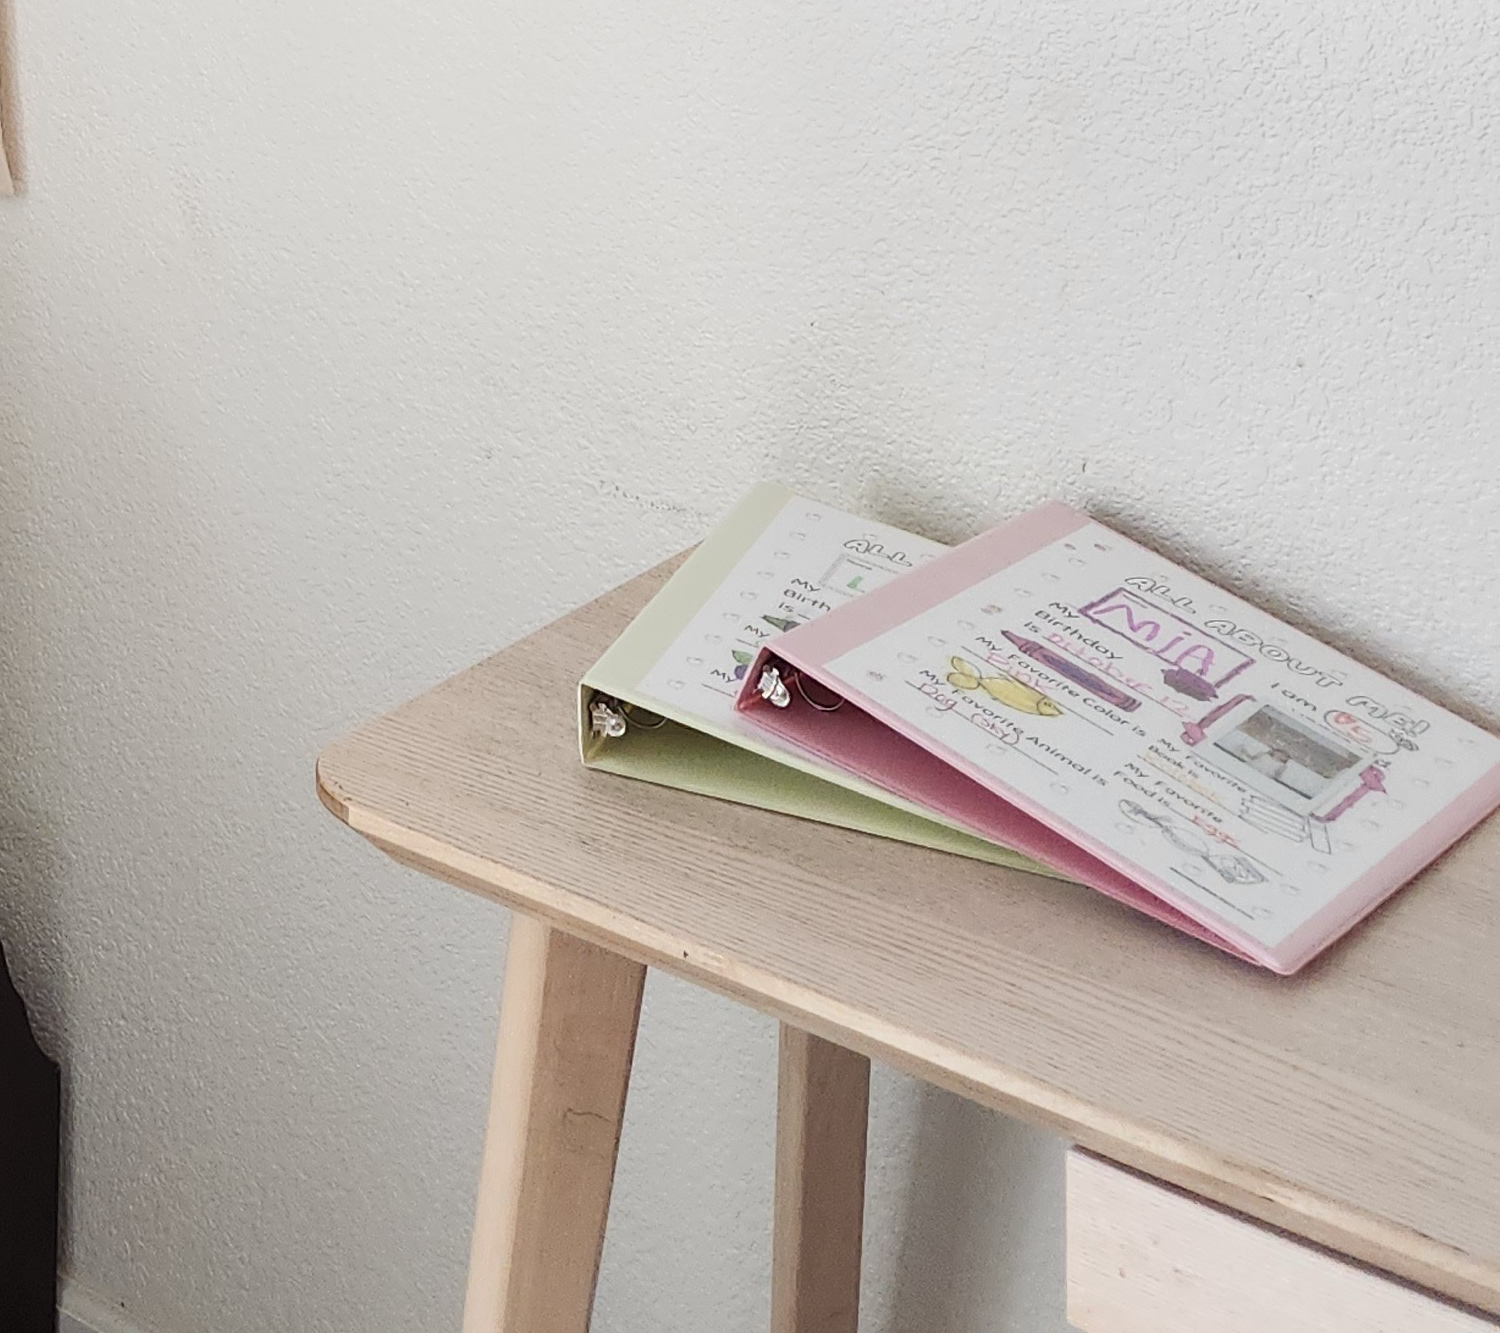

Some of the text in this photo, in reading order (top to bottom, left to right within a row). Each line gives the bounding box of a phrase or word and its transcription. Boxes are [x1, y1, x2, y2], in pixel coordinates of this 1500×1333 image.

[843, 539, 913, 568] ALL
[1034, 609, 1123, 662] Birthday
[1124, 577, 1196, 615] ALL
[1204, 619, 1344, 689] ABOUT
[919, 683, 958, 712] Dog
[1007, 653, 1081, 698] Favorite
[1082, 695, 1131, 728] Color
[1281, 689, 1317, 712] am
[951, 688, 1025, 735] Favorite
[1026, 734, 1092, 776] Animal
[1148, 745, 1185, 769] Book
[1185, 755, 1246, 793] Favorite
[1113, 770, 1157, 798] Food
[1154, 780, 1223, 823] Favorite
